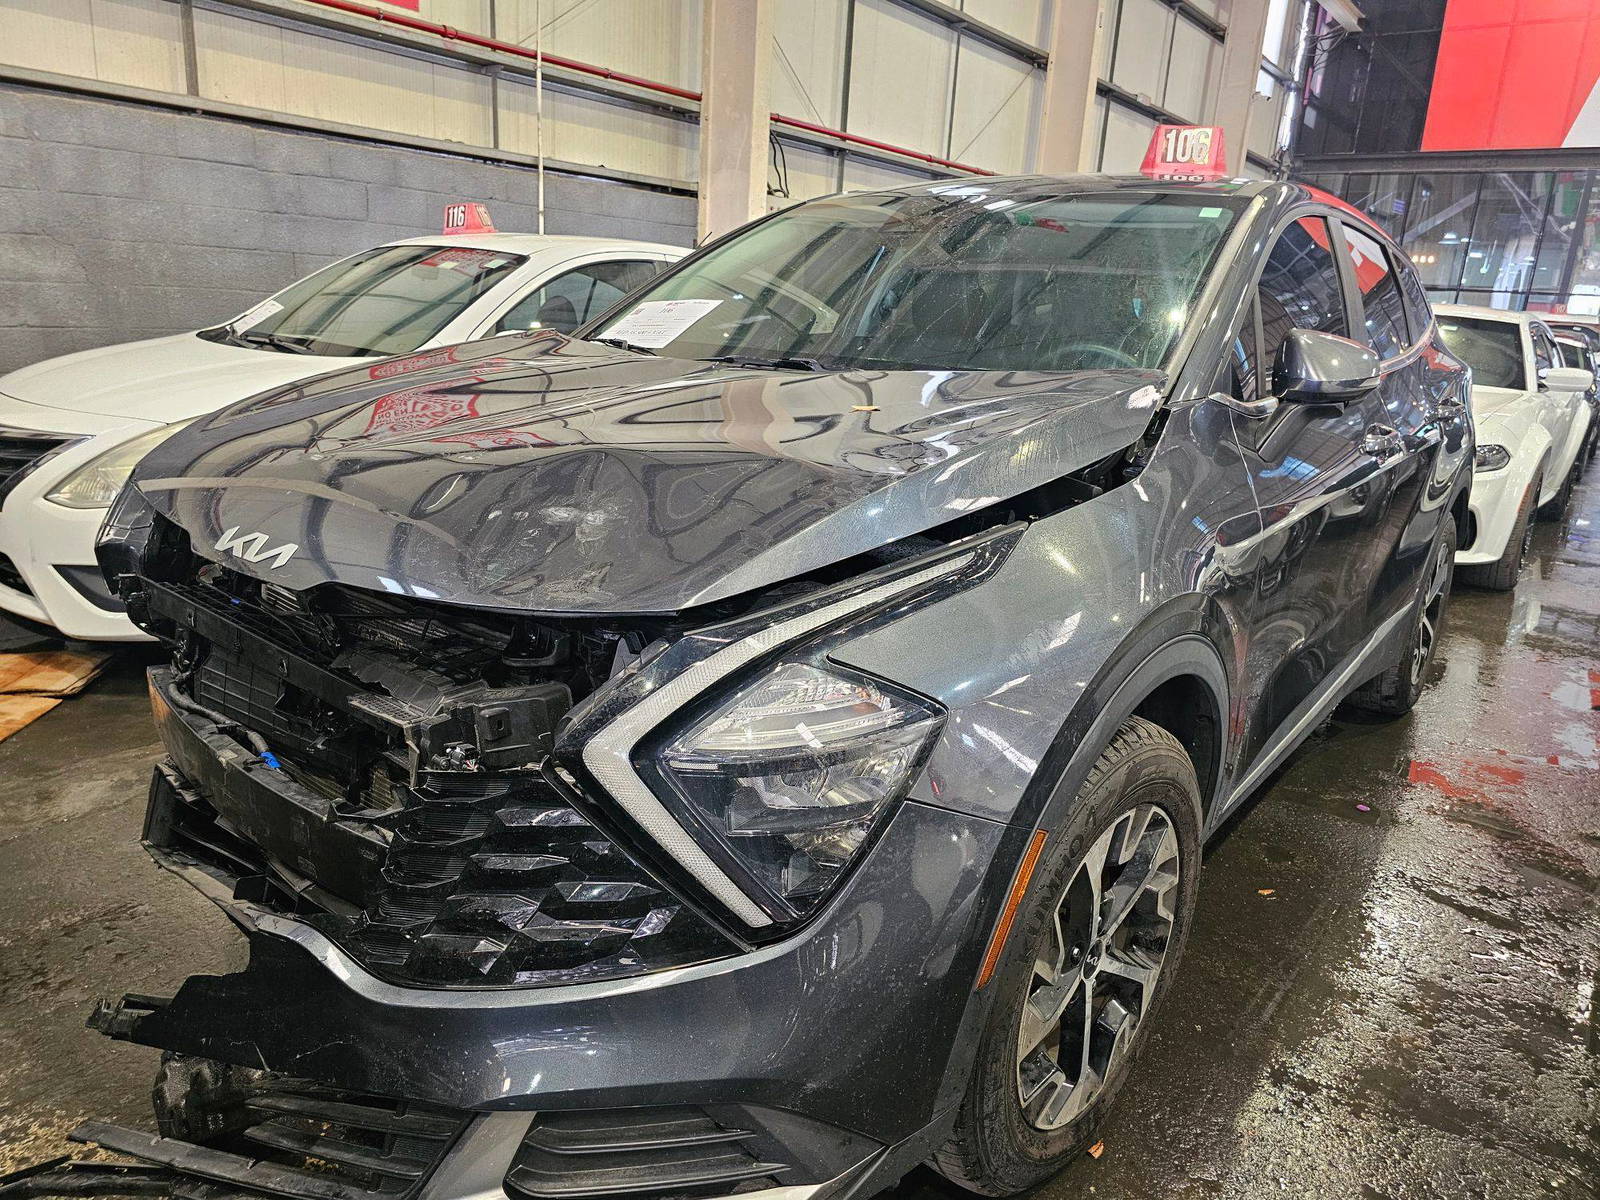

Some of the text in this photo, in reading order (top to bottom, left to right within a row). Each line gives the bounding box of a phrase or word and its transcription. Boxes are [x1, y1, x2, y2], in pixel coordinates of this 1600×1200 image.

[1164, 128, 1210, 164] 106
[448, 205, 465, 228] 116
[214, 525, 299, 570] KIA
